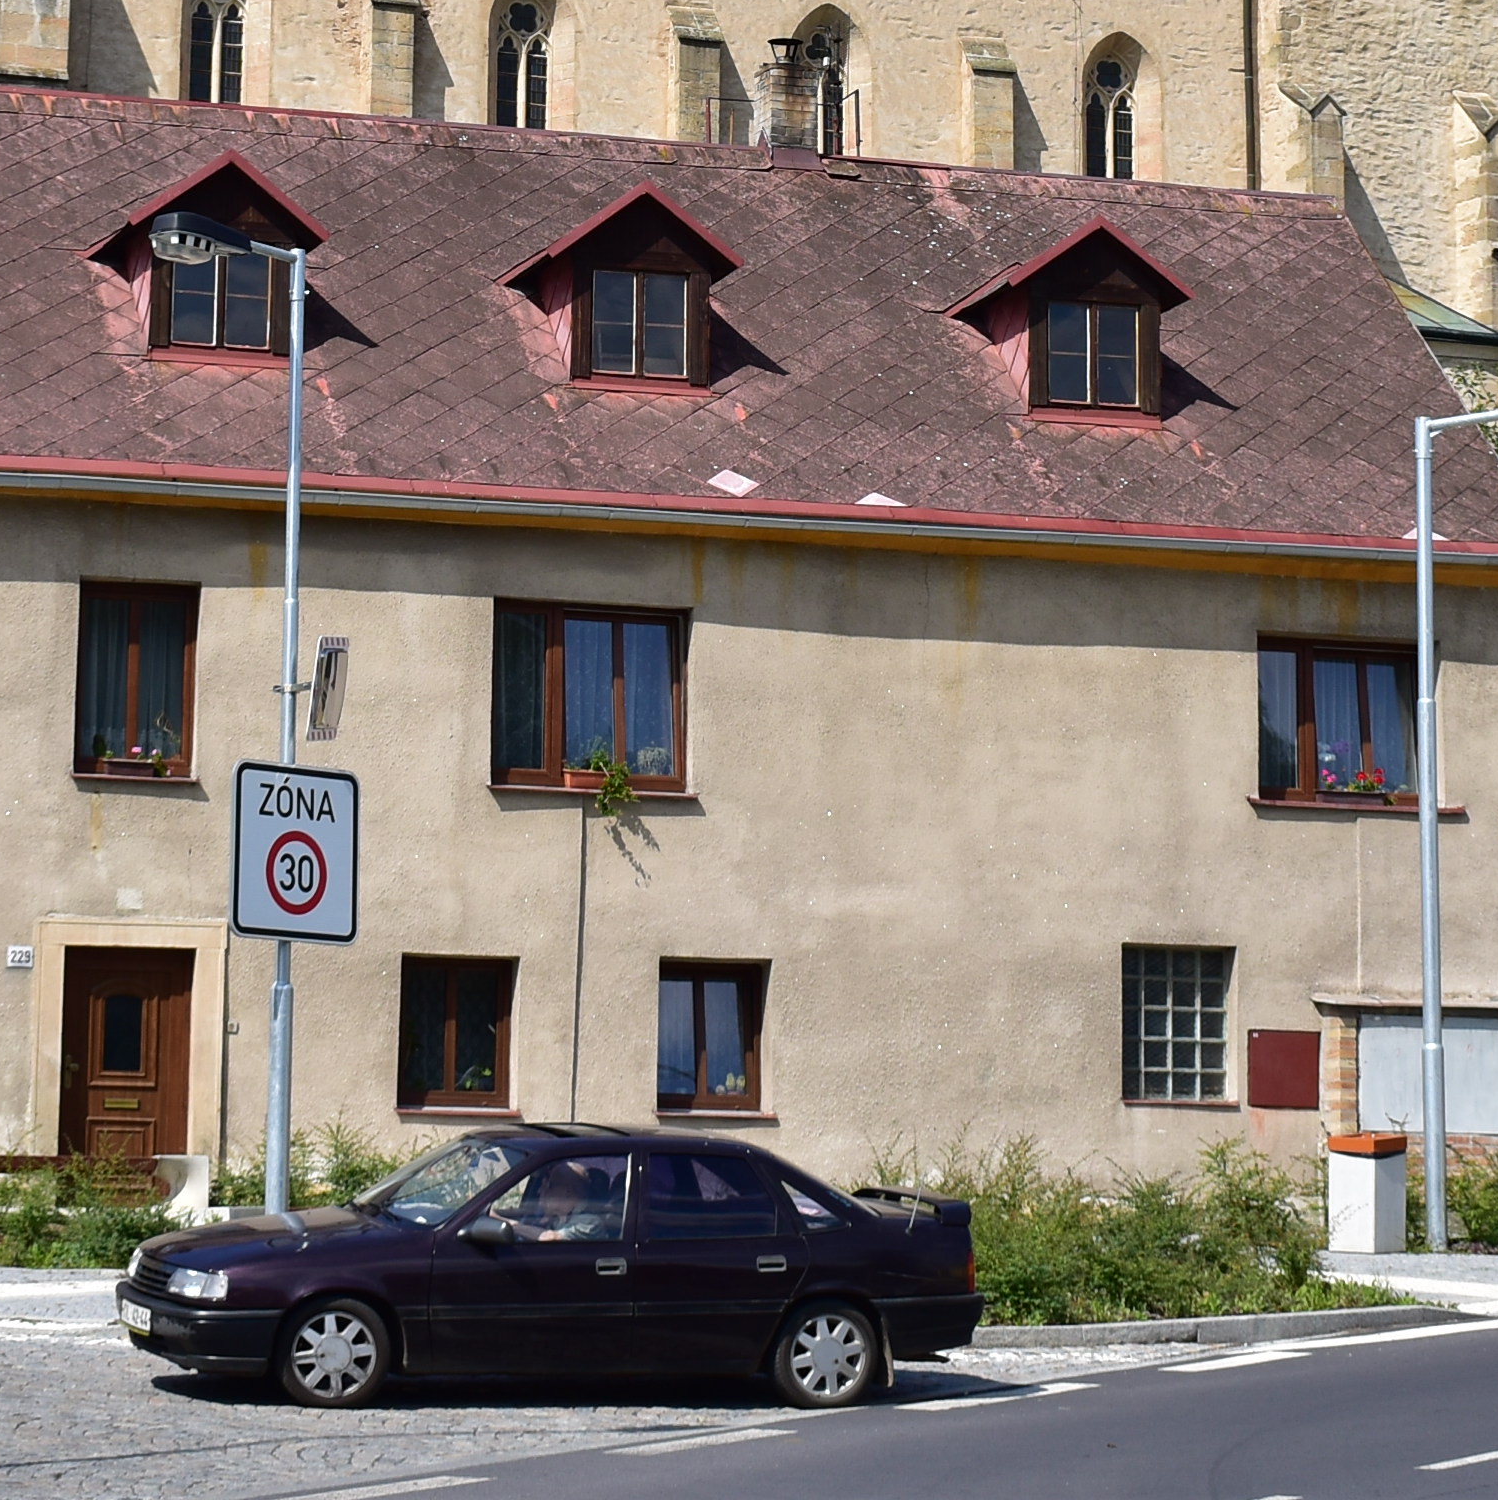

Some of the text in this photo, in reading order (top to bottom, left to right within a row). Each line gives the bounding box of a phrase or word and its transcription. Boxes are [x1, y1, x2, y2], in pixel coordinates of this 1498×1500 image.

[259, 777, 335, 823] ZÓNA
[279, 853, 314, 893] 30
[10, 950, 31, 964] 229
